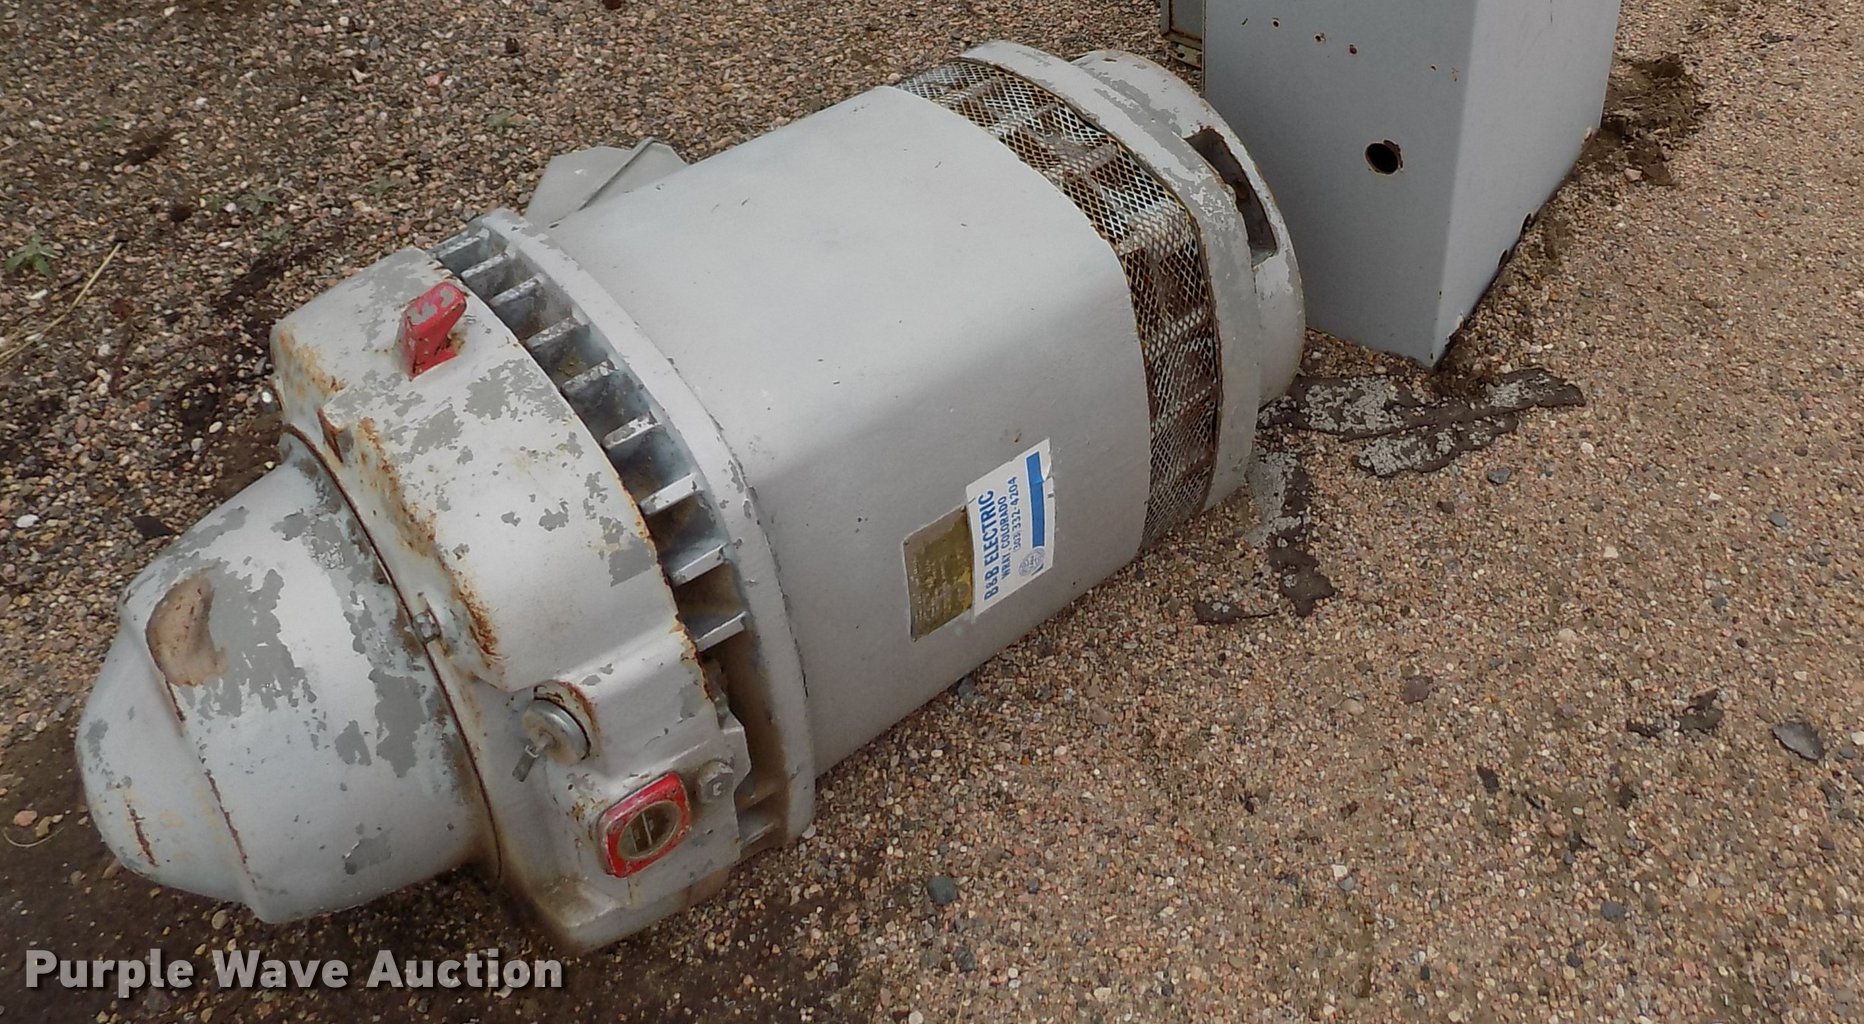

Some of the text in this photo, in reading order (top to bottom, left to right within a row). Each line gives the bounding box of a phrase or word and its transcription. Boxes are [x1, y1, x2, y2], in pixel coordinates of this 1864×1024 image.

[998, 496, 1010, 549] COLORADO
[1008, 477, 1021, 531] 332-4204
[979, 491, 1000, 600] B&B ELECTRIC
